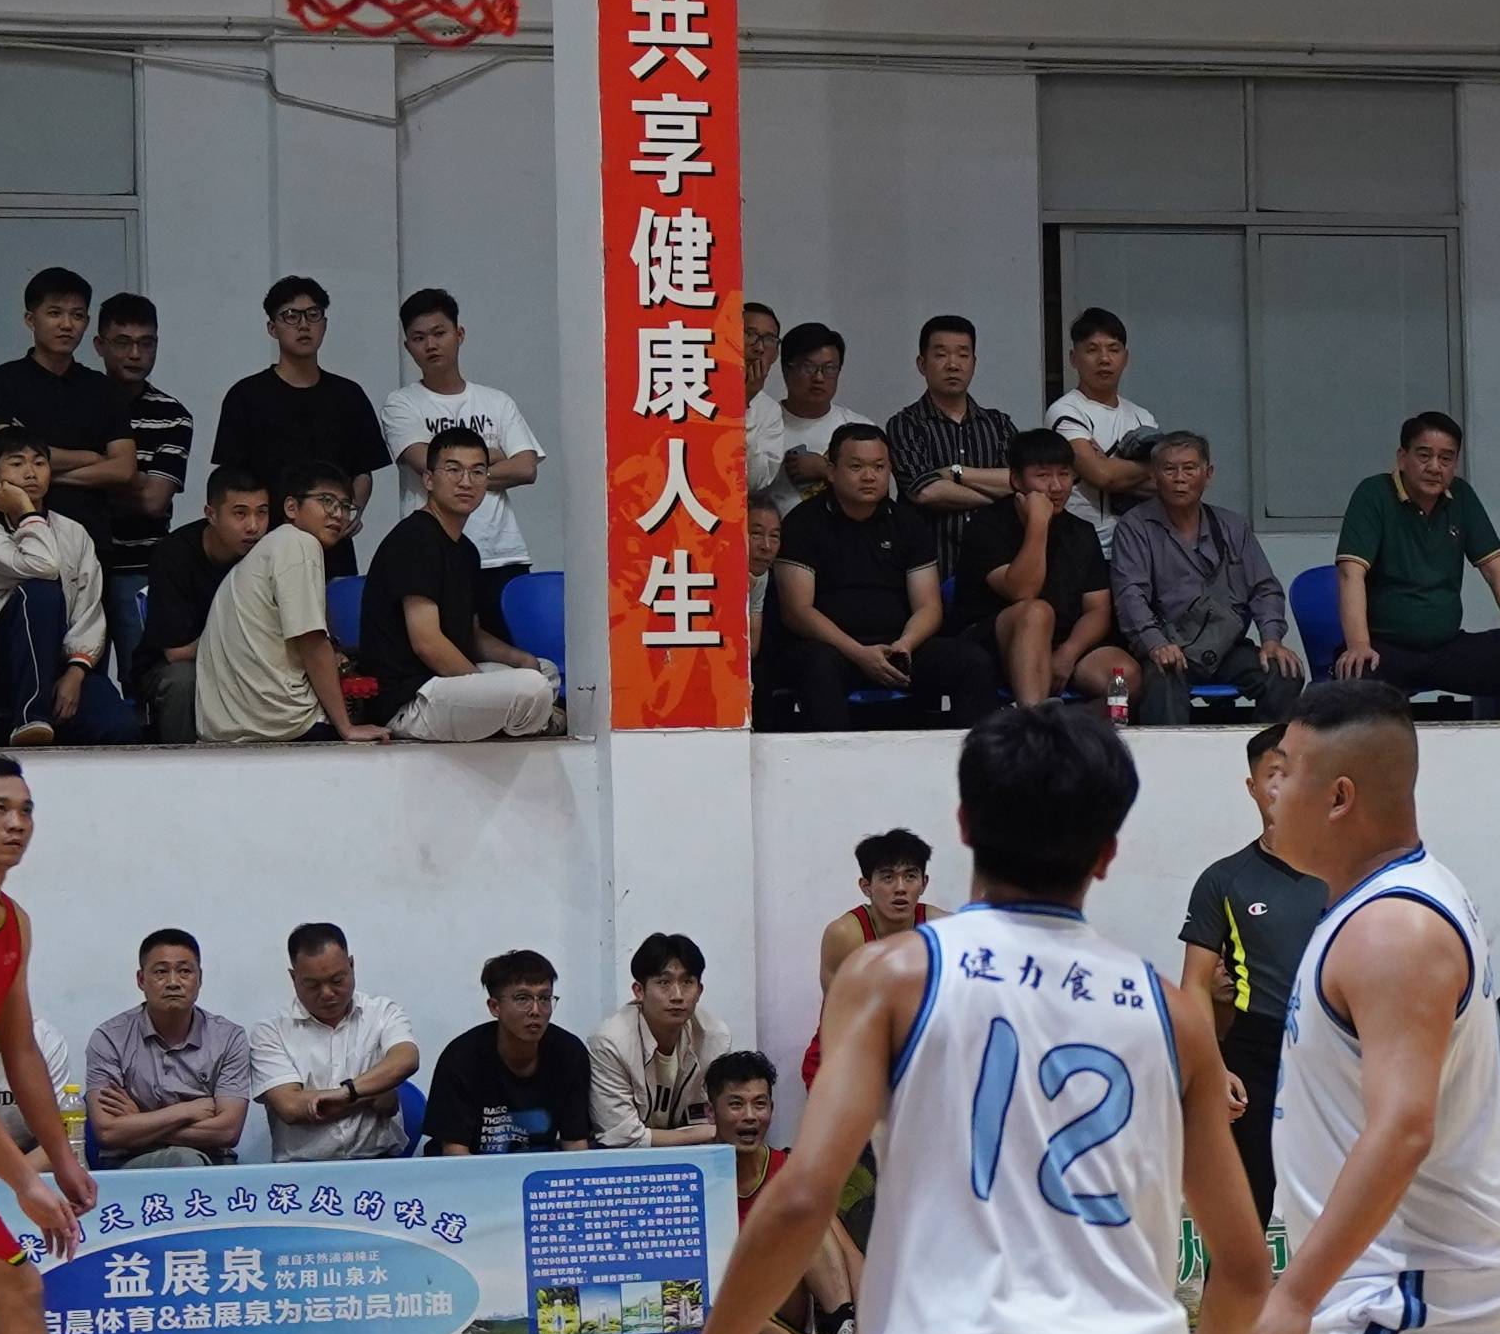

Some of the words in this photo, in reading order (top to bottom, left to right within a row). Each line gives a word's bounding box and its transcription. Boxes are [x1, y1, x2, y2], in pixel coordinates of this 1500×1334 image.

[957, 947, 1146, 1011] 健力食品
[970, 1016, 1136, 1228] 12
[103, 1245, 269, 1299] 益展泉
[274, 1267, 389, 1291] 饮用山泉水
